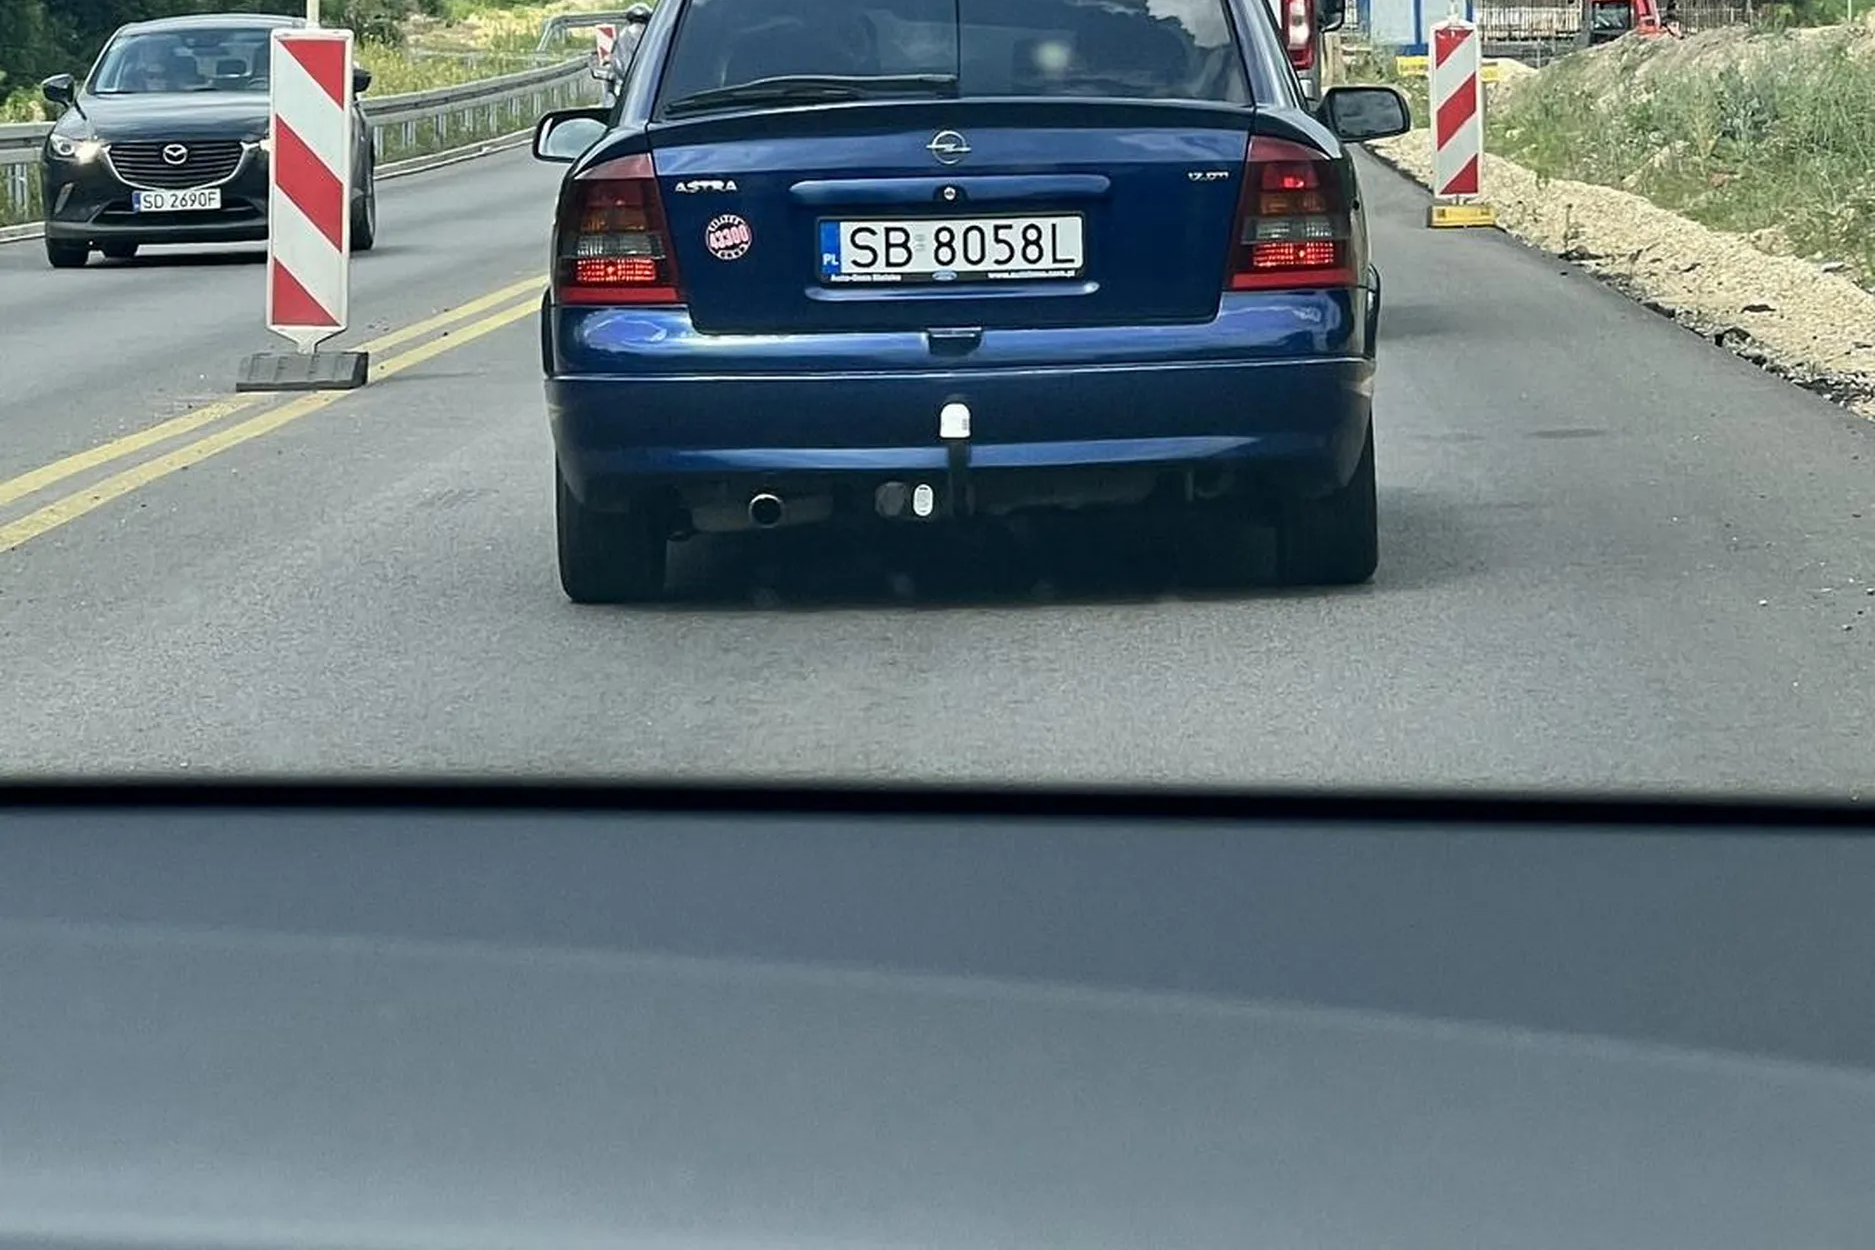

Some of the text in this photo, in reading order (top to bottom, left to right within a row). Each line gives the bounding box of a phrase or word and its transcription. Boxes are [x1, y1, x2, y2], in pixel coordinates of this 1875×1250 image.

[674, 180, 737, 193] ASTRA
[142, 191, 217, 209] SD 2690F
[849, 222, 1077, 269] SB 8058L
[822, 252, 840, 266] PL
